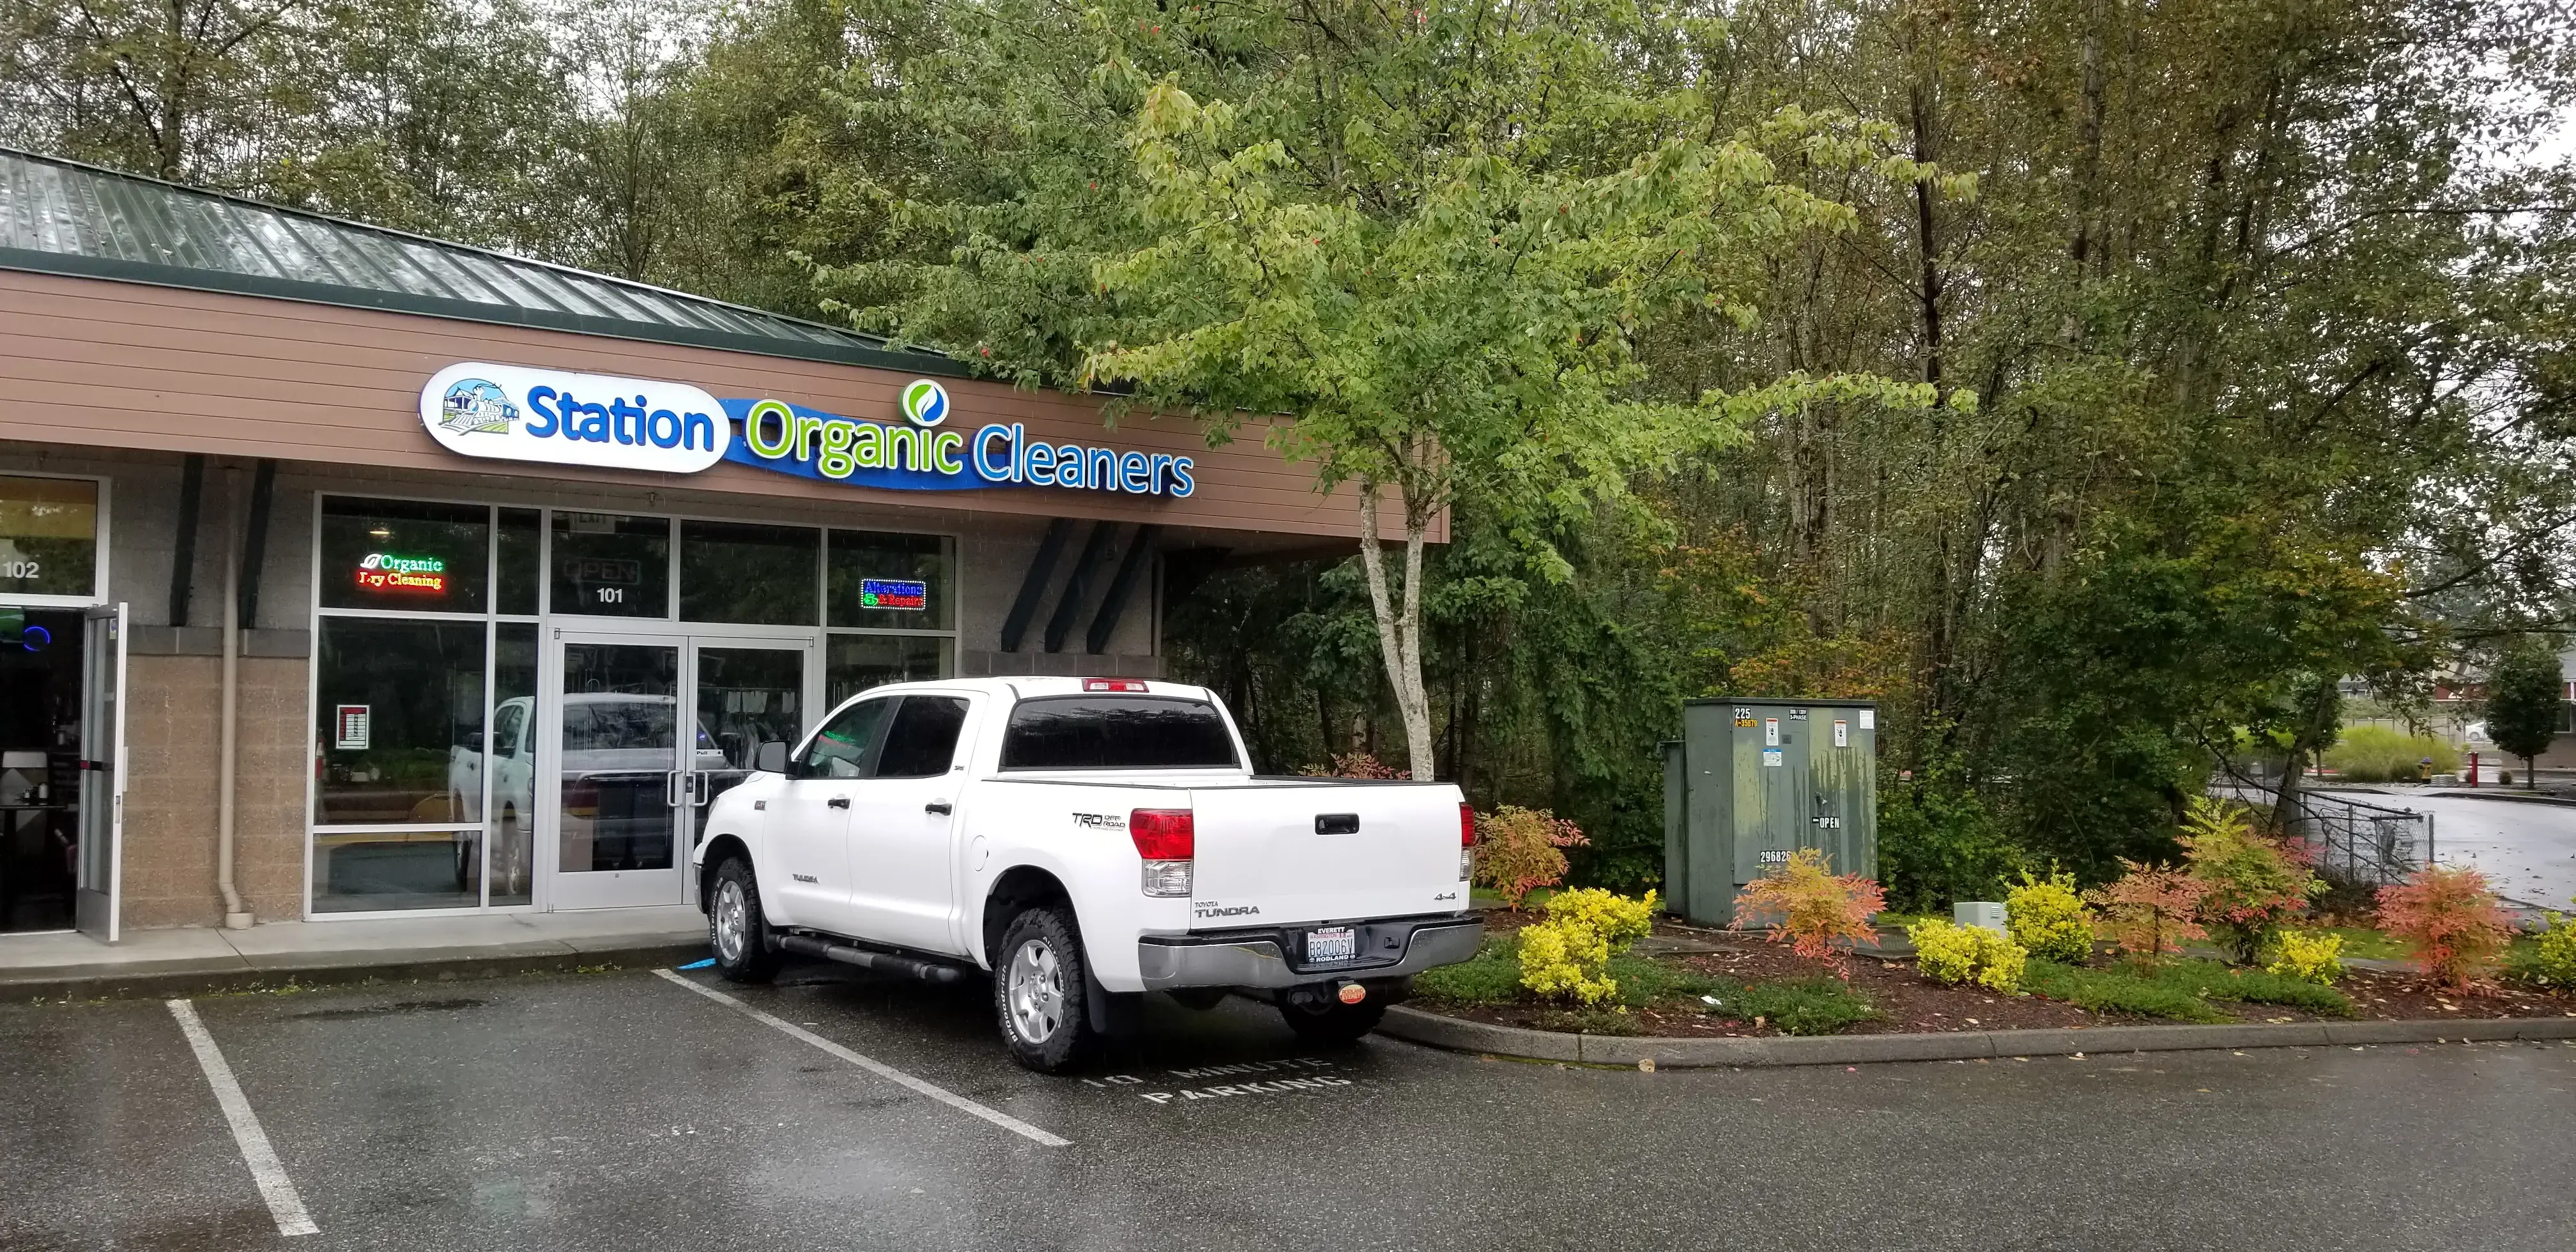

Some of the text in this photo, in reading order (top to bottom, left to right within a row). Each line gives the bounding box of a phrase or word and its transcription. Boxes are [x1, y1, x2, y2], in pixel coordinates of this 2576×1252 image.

[526, 385, 1195, 498] Station Organic Cleaners
[3, 561, 39, 578] 102
[380, 554, 443, 574] Organic
[387, 572, 442, 591] Cleaning
[597, 587, 622, 603] 101
[1735, 708, 1751, 719] 225
[1072, 812, 1103, 828] TRD
[1820, 817, 1839, 828] OPEN
[1760, 850, 1791, 862] 296826
[1194, 905, 1260, 918] TUNDRA
[1310, 938, 1353, 957] B82006V
[1316, 954, 1349, 963] RODLAND
[1000, 965, 1018, 1042] BFGoodrich
[1081, 1057, 1334, 1087] 10 MINUTE
[1139, 1075, 1352, 1104] PARKING
